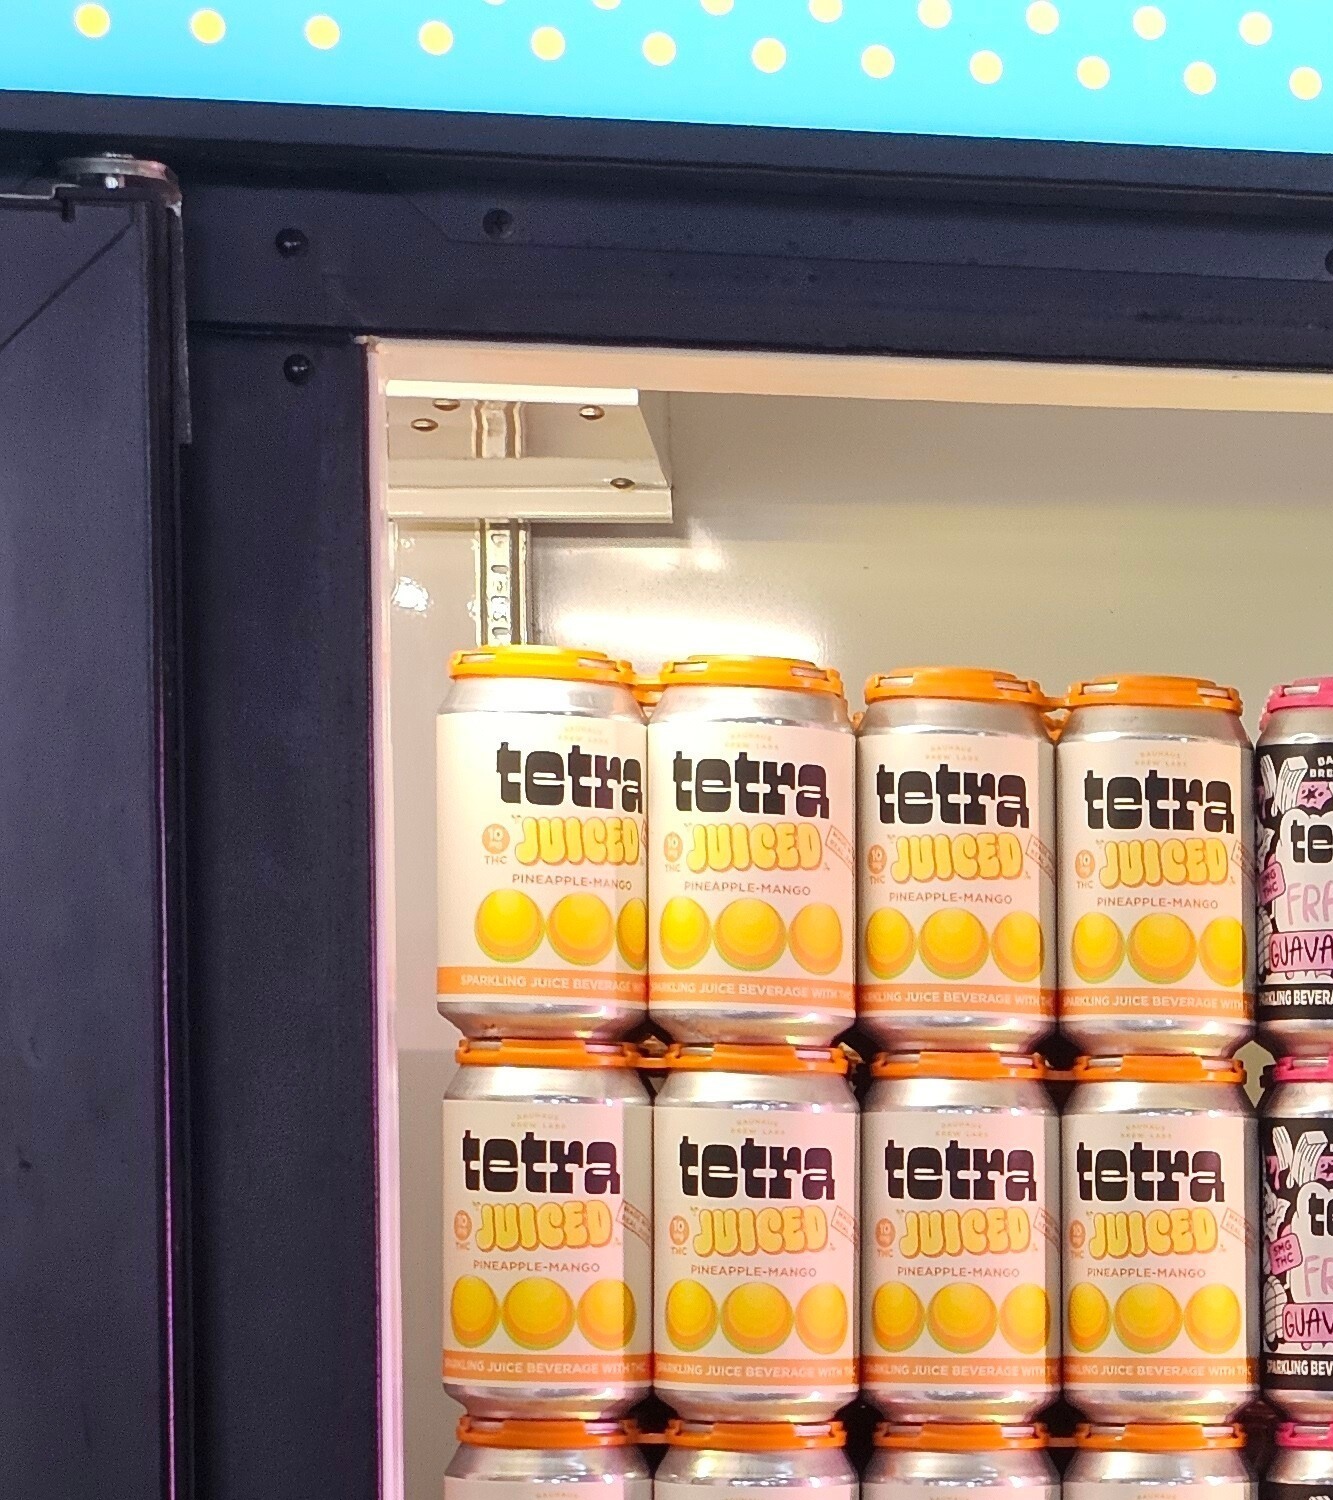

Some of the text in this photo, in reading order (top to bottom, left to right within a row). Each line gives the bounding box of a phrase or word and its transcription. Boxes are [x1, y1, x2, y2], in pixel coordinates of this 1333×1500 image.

[497, 742, 642, 813] tetra
[672, 751, 830, 819] tetra
[876, 763, 1029, 828] tetra
[1084, 769, 1234, 834] tetra
[515, 816, 639, 867] JUICED
[686, 822, 823, 873] JUICED
[891, 833, 1023, 885] JUICED
[1099, 838, 1228, 890] JUICED
[512, 874, 632, 891] PINEAPPLE-MANGO
[684, 880, 811, 896] PINEAPPLE-MANGO
[889, 891, 1012, 905] PINEAPPLE-MANGO
[1097, 897, 1218, 909] PINEAPPLE-MANGO
[460, 973, 631, 992] SPARKLING JUICE BEVERAGE
[462, 1129, 620, 1195] tetra
[679, 1136, 835, 1201] tetra
[884, 1139, 1037, 1201] tetra
[1076, 1142, 1225, 1202] tetra
[475, 1201, 612, 1253] JUICED
[692, 1206, 829, 1258] JUICED
[899, 1208, 1030, 1260] JUICED
[1088, 1208, 1218, 1261] JUICED
[473, 1260, 600, 1273] PINEAPPLE-MANGO
[691, 1264, 817, 1278] PINEAPPLE-MANGO
[897, 1266, 1020, 1279] PINEAPPLE-MANGO
[1087, 1267, 1206, 1279] PINEAPPLE-MANGO
